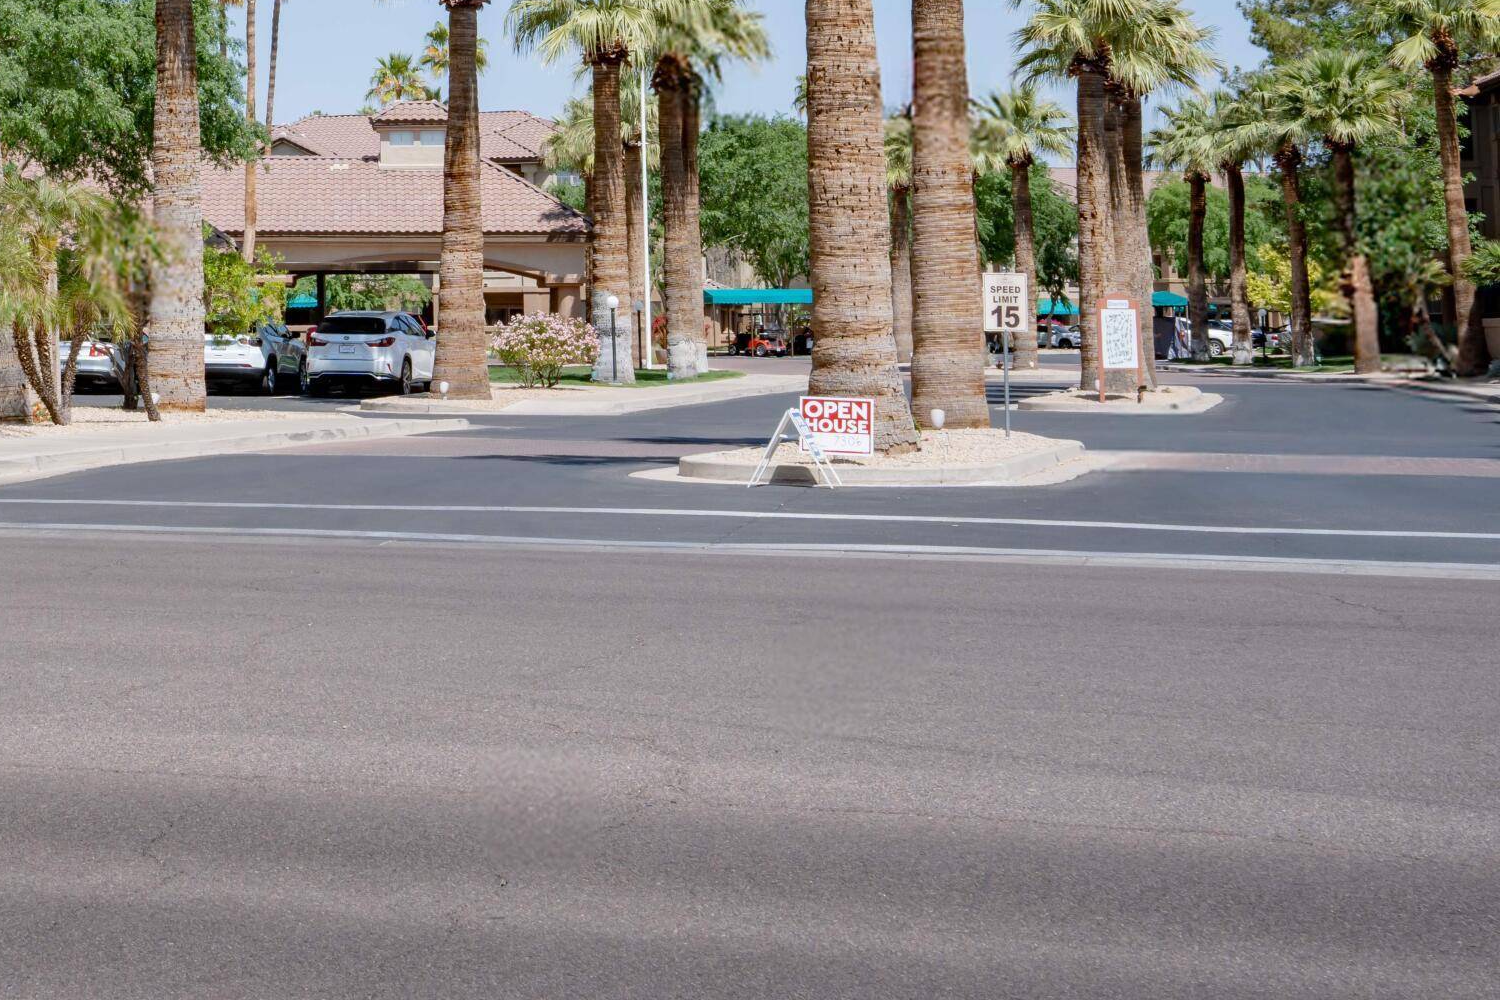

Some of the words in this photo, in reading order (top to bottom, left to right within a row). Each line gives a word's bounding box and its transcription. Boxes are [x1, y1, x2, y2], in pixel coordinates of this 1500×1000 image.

[990, 285, 1021, 294] SPEED
[991, 305, 1020, 328] 15
[804, 400, 868, 420] OPEN
[805, 418, 869, 434] HOUSE
